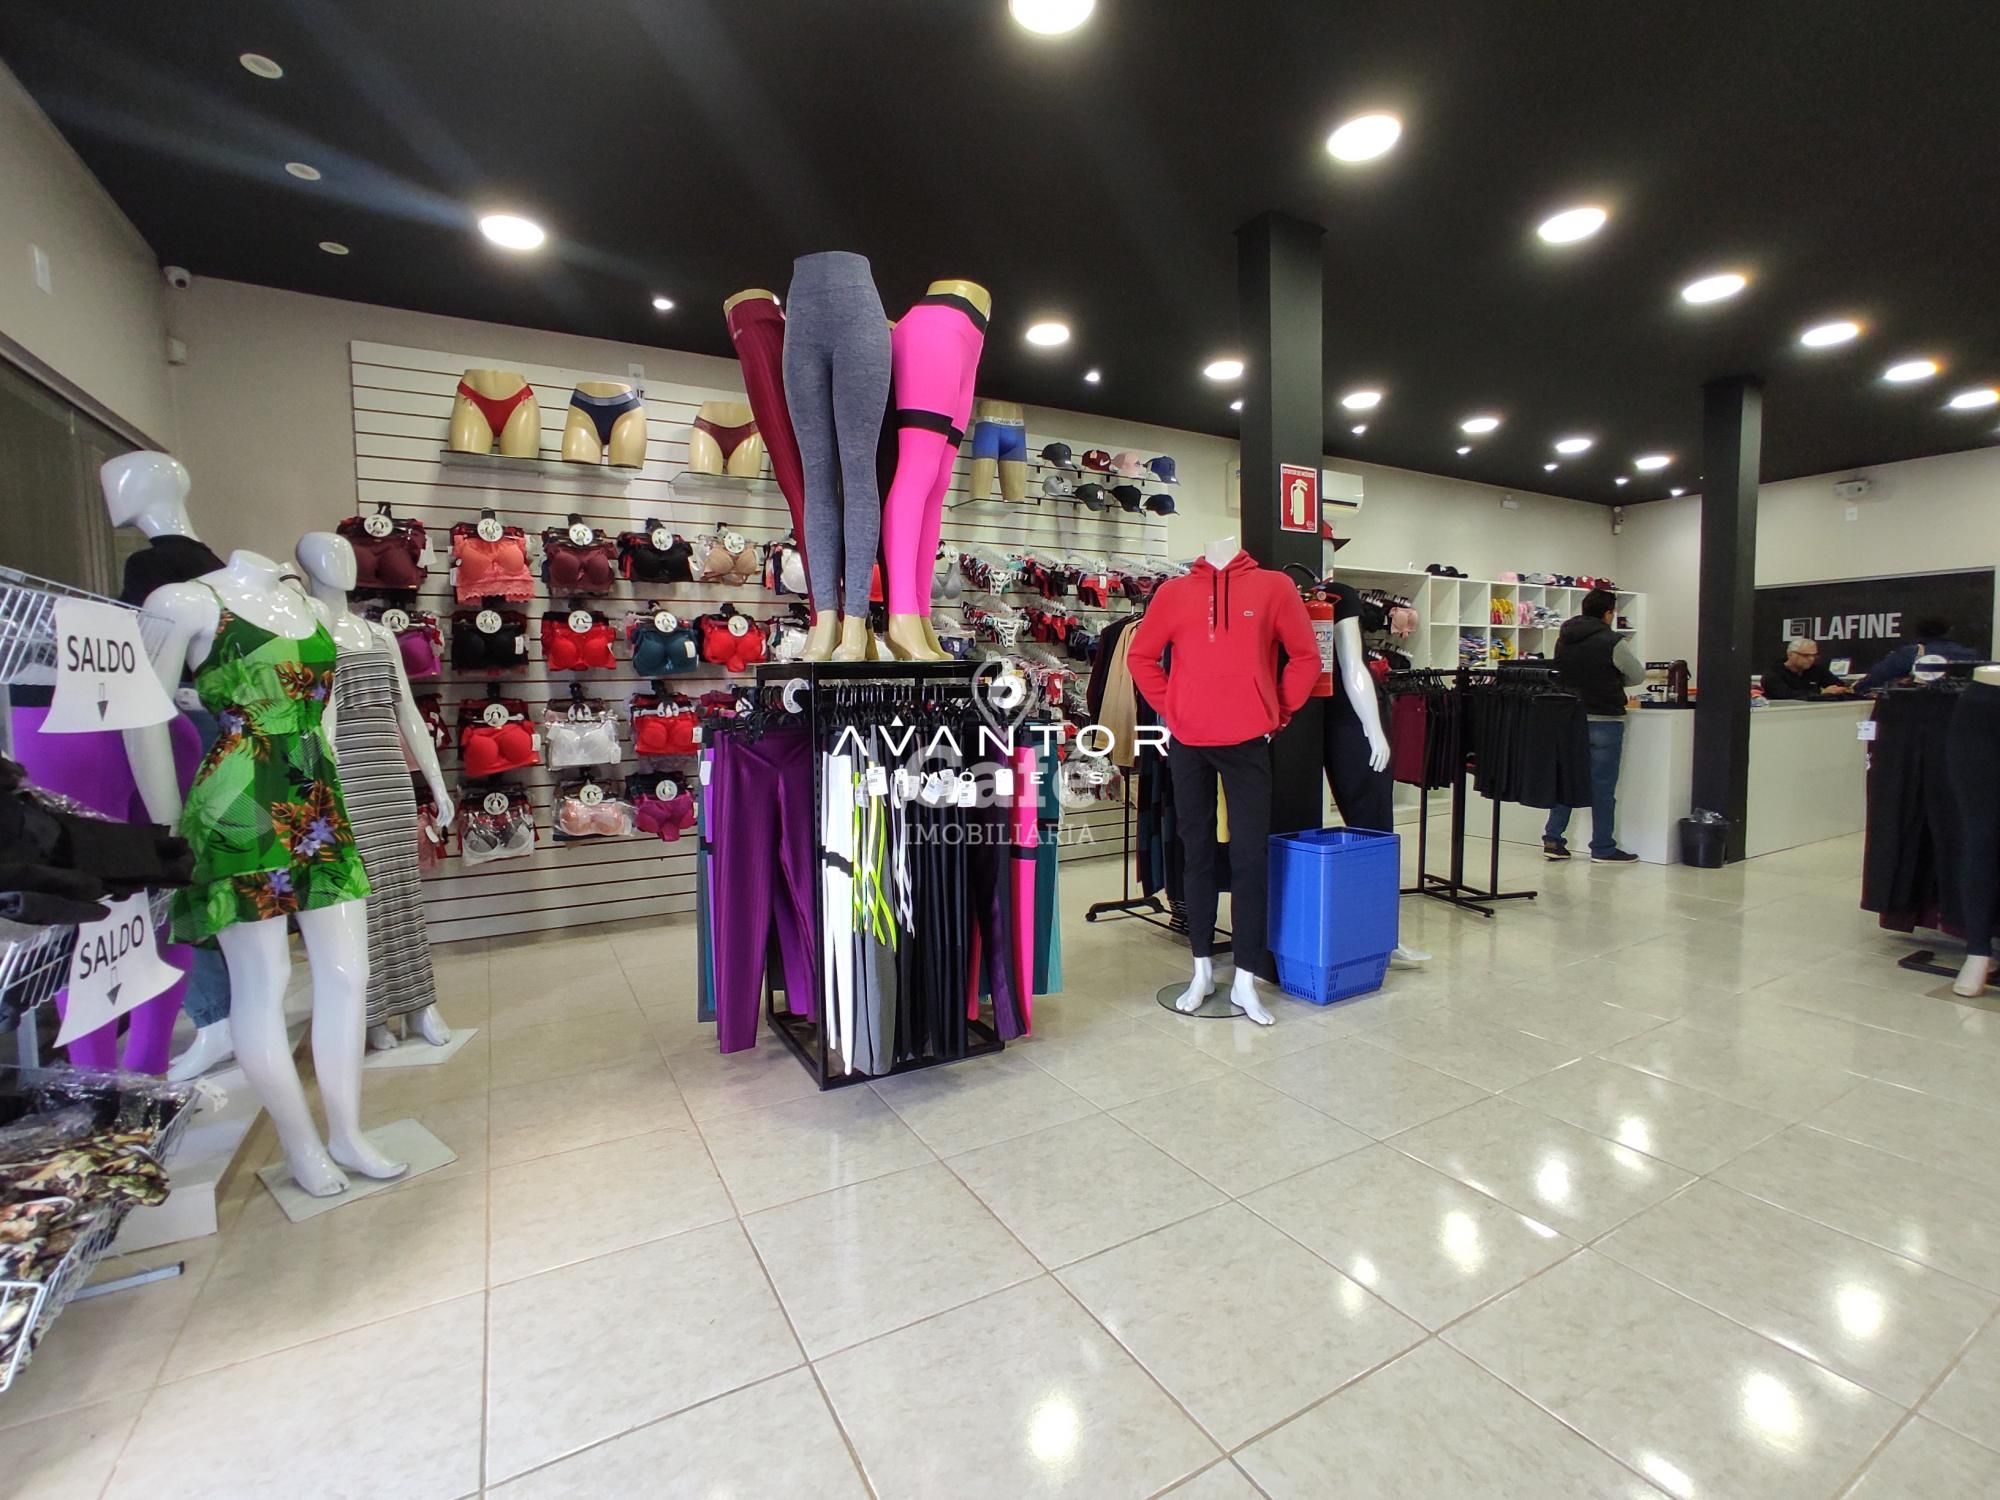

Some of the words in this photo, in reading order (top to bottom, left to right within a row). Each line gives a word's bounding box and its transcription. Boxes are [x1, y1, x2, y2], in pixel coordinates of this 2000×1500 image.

[1814, 613, 1901, 641] LAFINE
[66, 634, 137, 675] SALDO
[78, 914, 146, 981] SALDO
